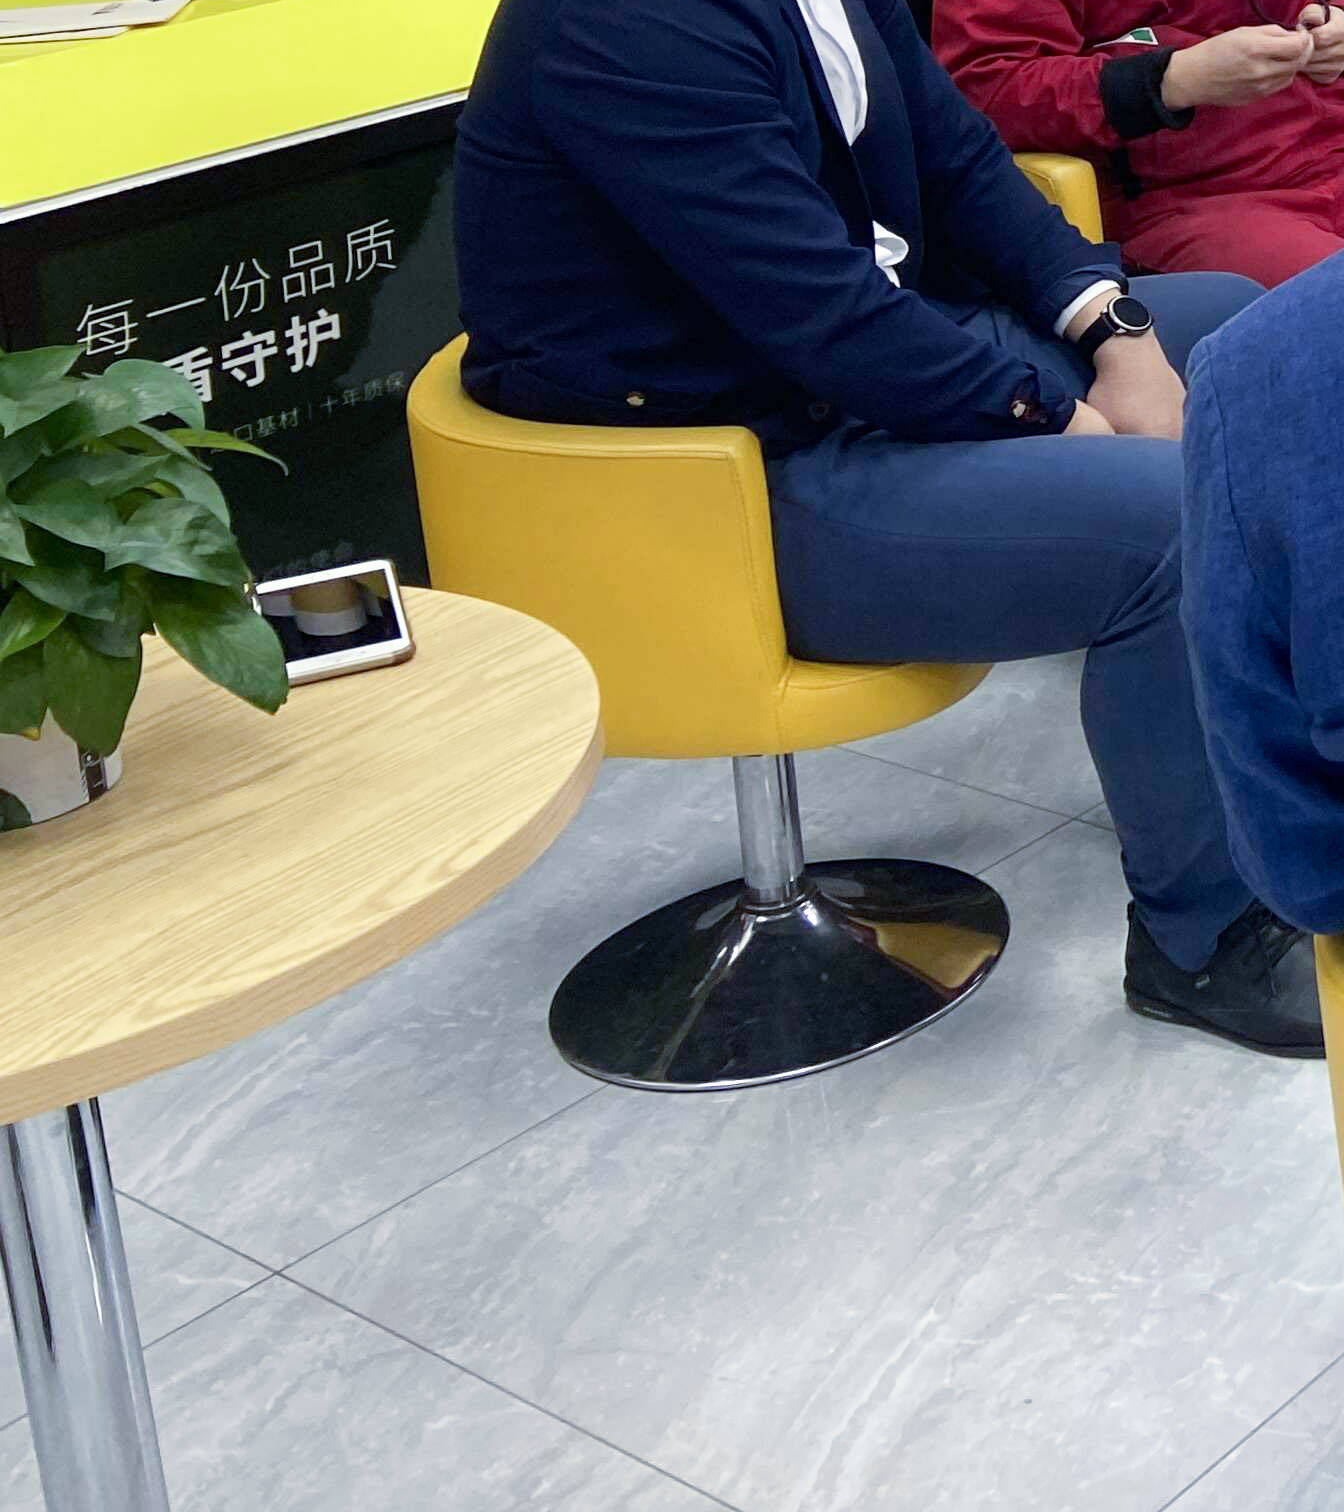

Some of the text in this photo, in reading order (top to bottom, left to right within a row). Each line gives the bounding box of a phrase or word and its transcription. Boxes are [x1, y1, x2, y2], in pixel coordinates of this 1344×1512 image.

[76, 219, 398, 356] 每一份品质
